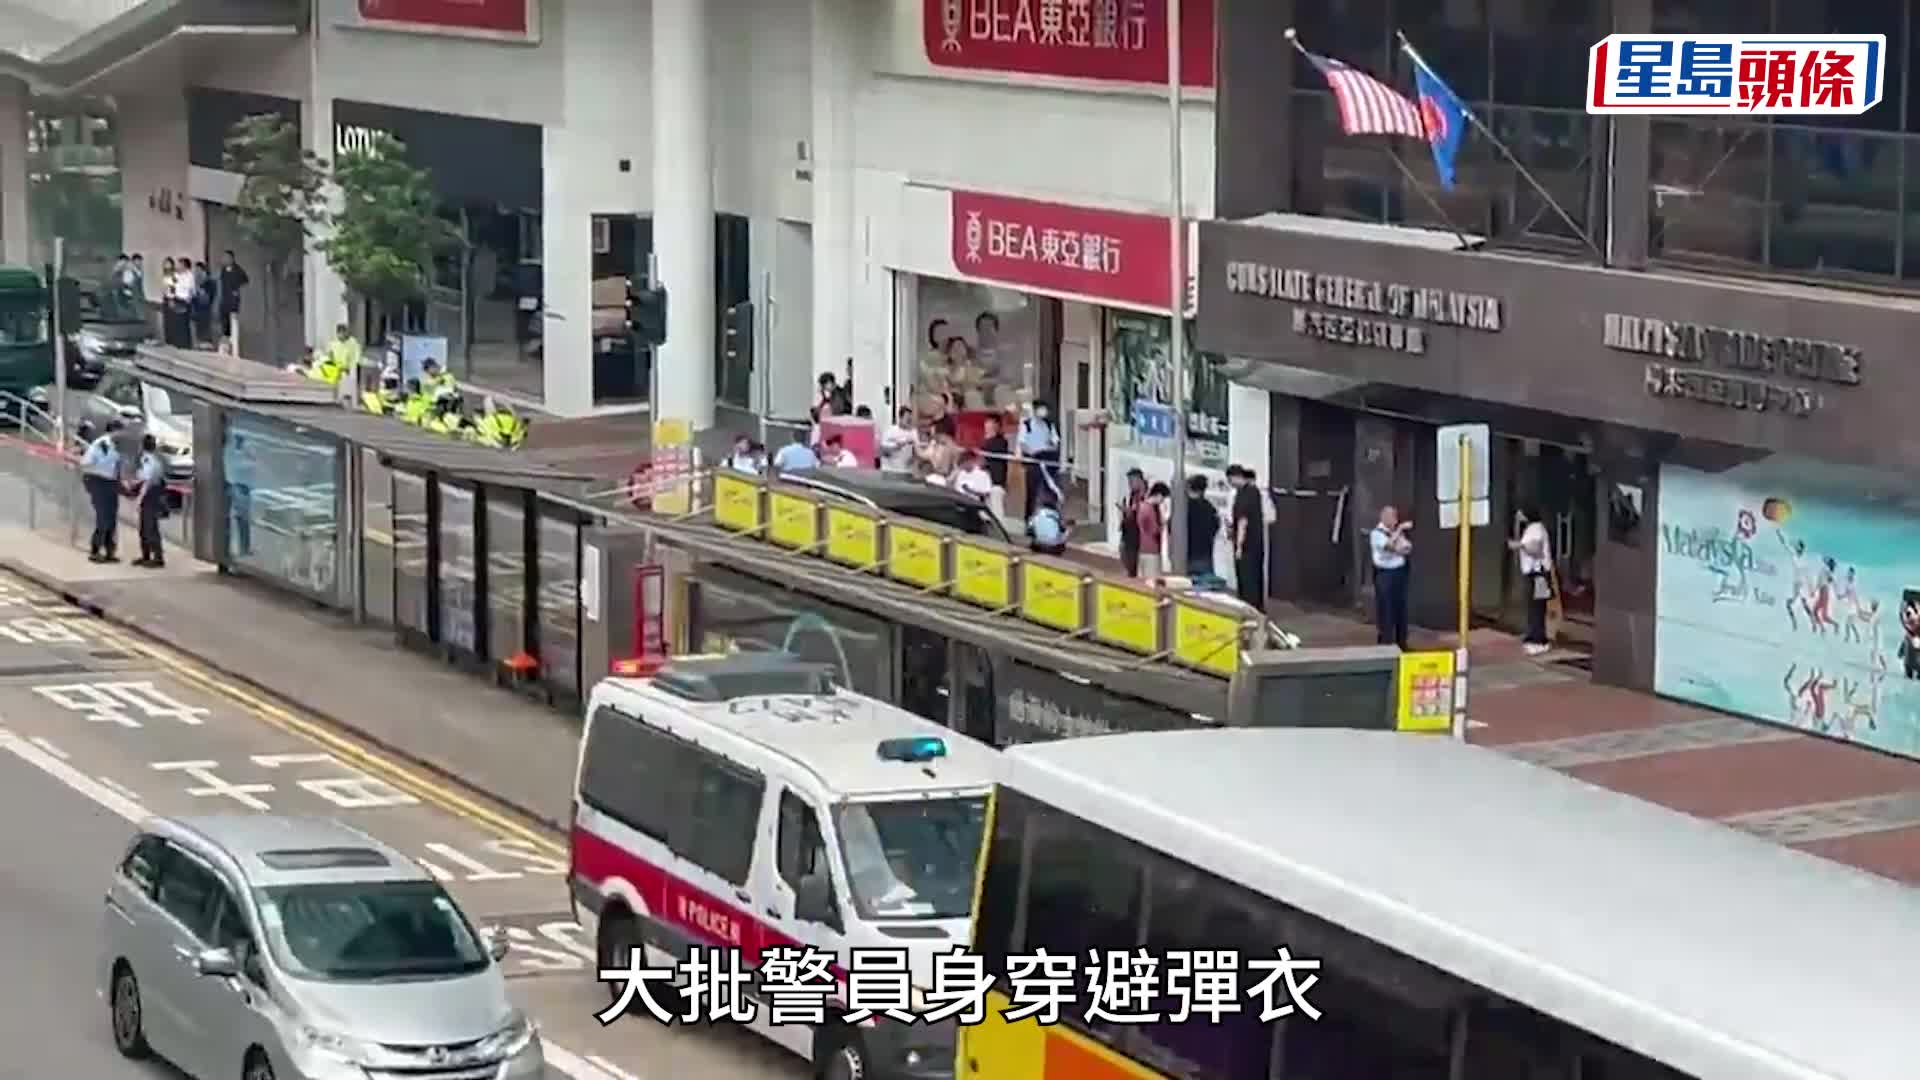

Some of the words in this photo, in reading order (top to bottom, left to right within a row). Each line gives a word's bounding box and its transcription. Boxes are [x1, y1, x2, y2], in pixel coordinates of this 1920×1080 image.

[969, 0, 1036, 43] BEA
[1038, 0, 1148, 49] 東亞銀行
[987, 219, 1038, 262] BEA
[1040, 228, 1122, 275] 東亞銀行
